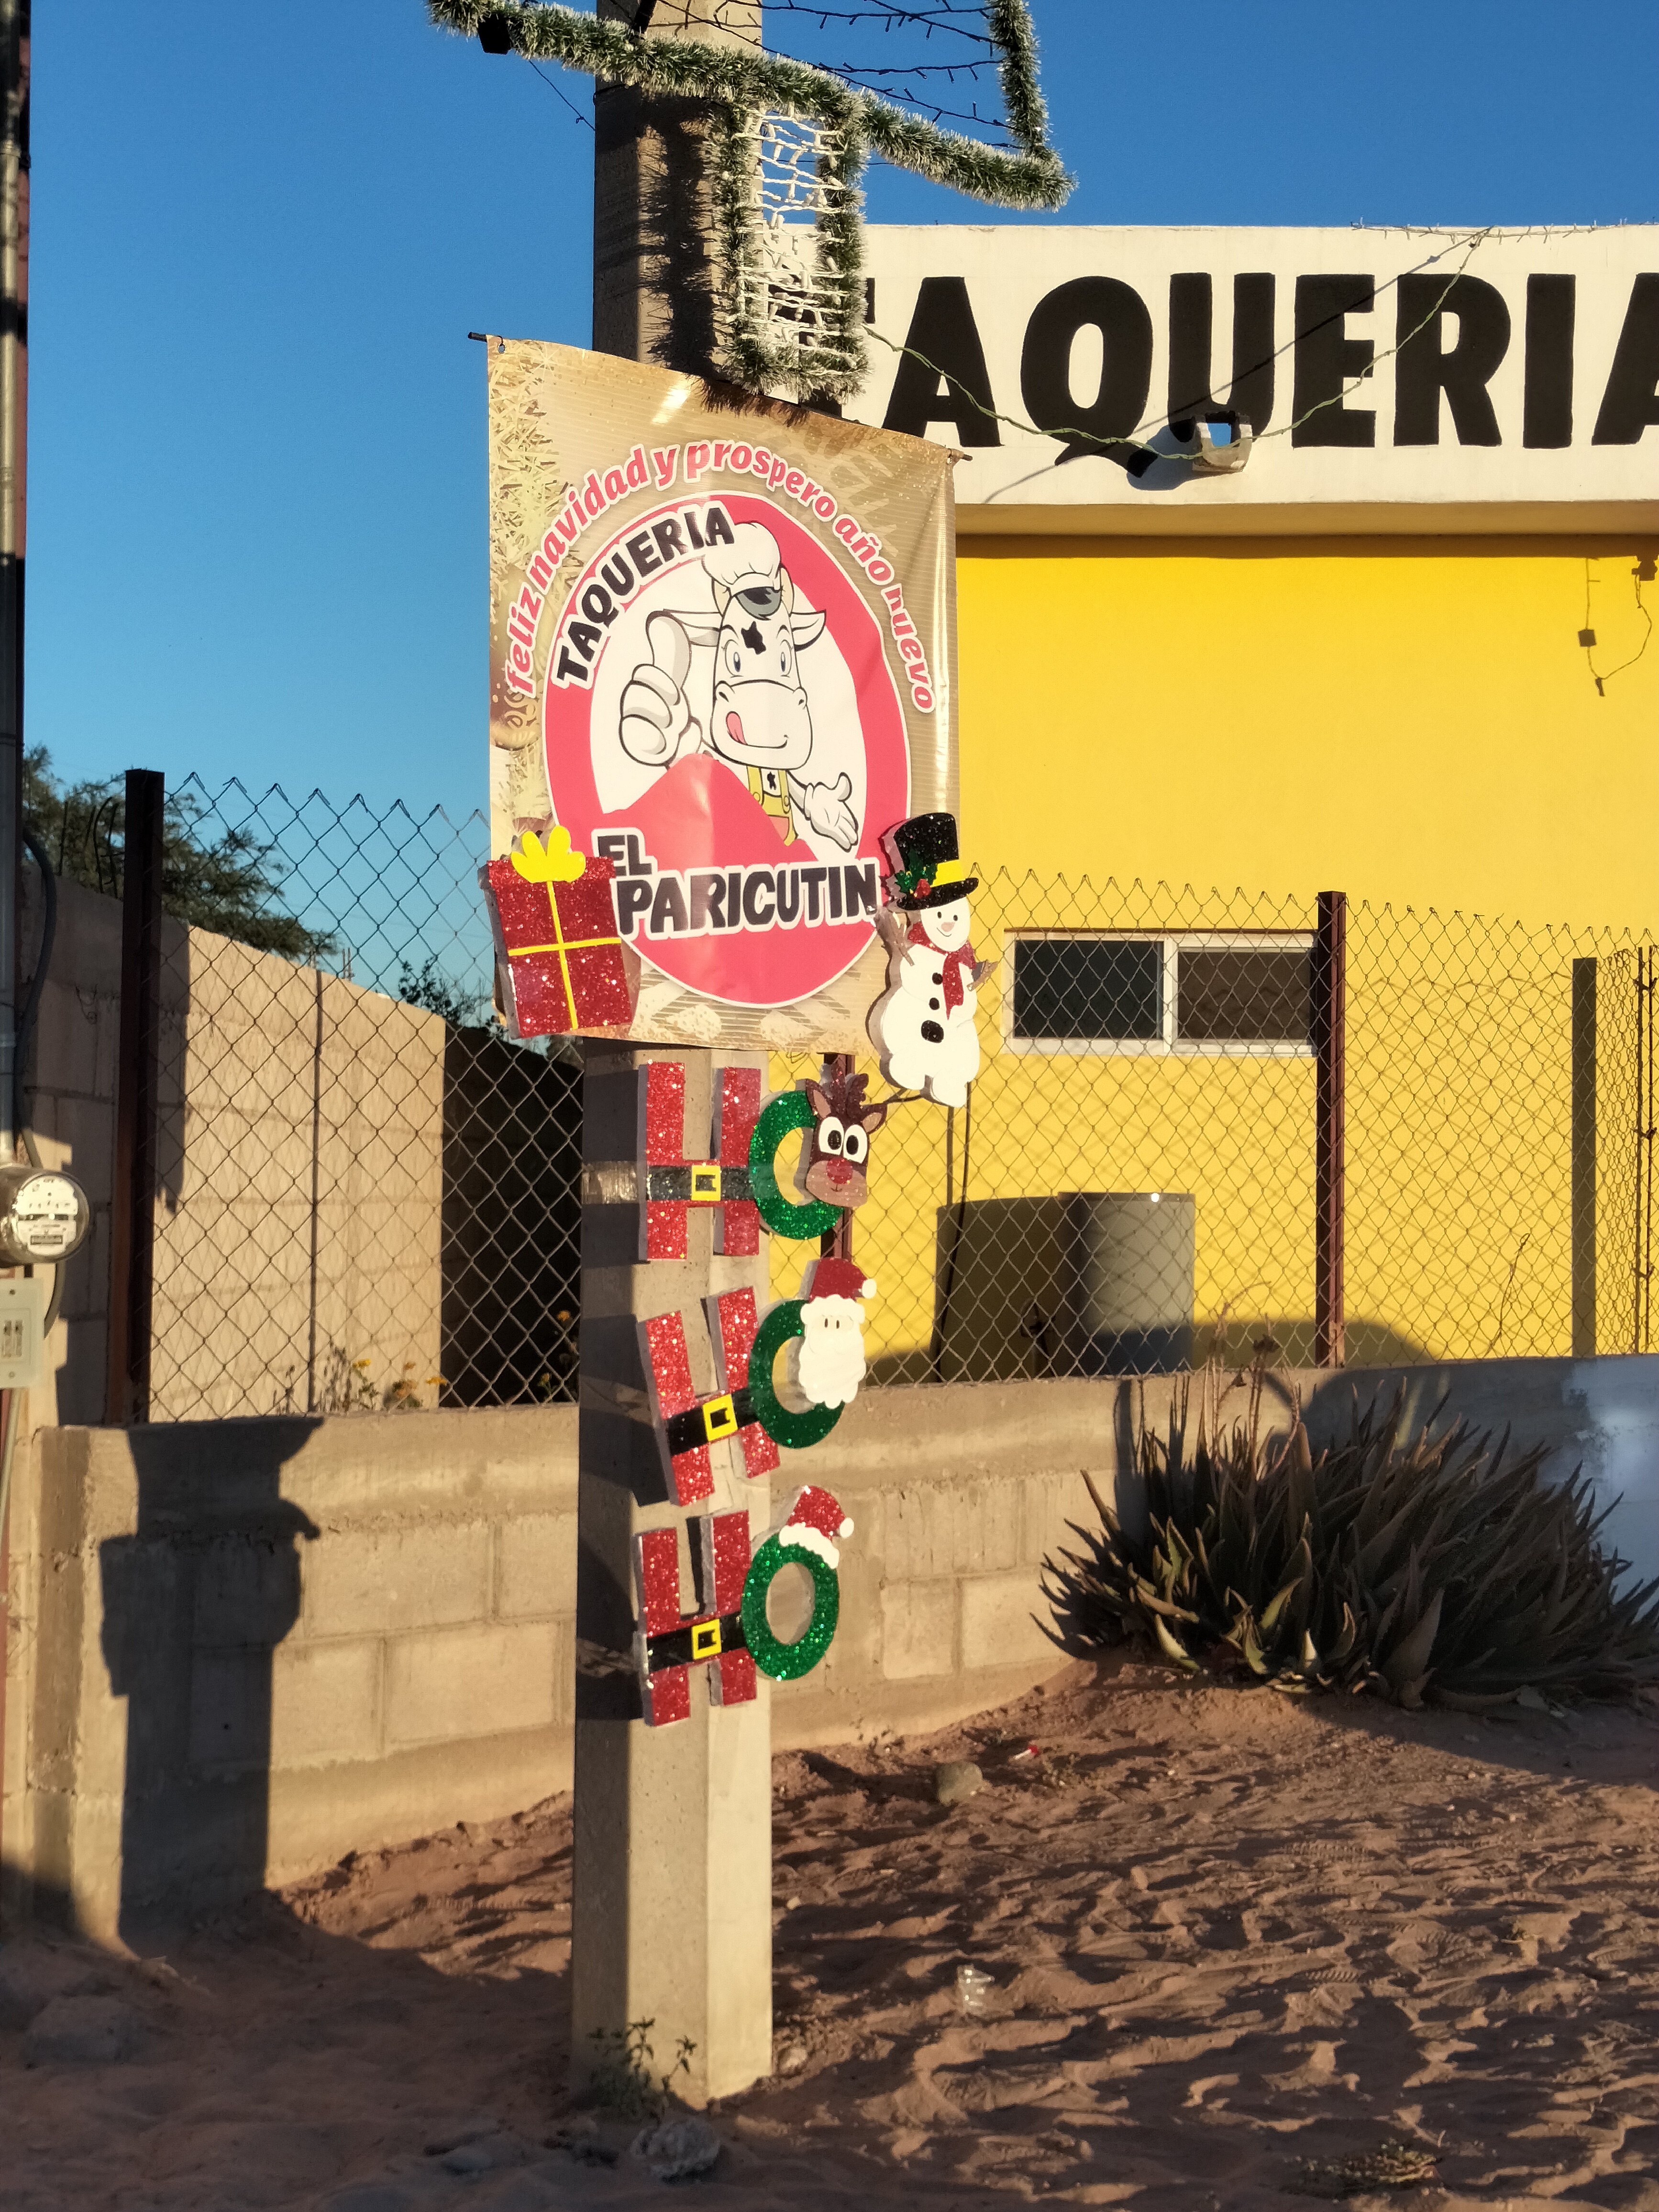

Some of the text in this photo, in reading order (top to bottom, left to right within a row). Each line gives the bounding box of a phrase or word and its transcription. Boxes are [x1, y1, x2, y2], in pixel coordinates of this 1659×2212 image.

[507, 442, 933, 709] feliz navidad y prospero año nuevo
[556, 507, 735, 682] TAQUERIA
[597, 834, 652, 876] EL
[617, 864, 877, 934] PARICUTIN
[639, 1510, 840, 1726] HO
